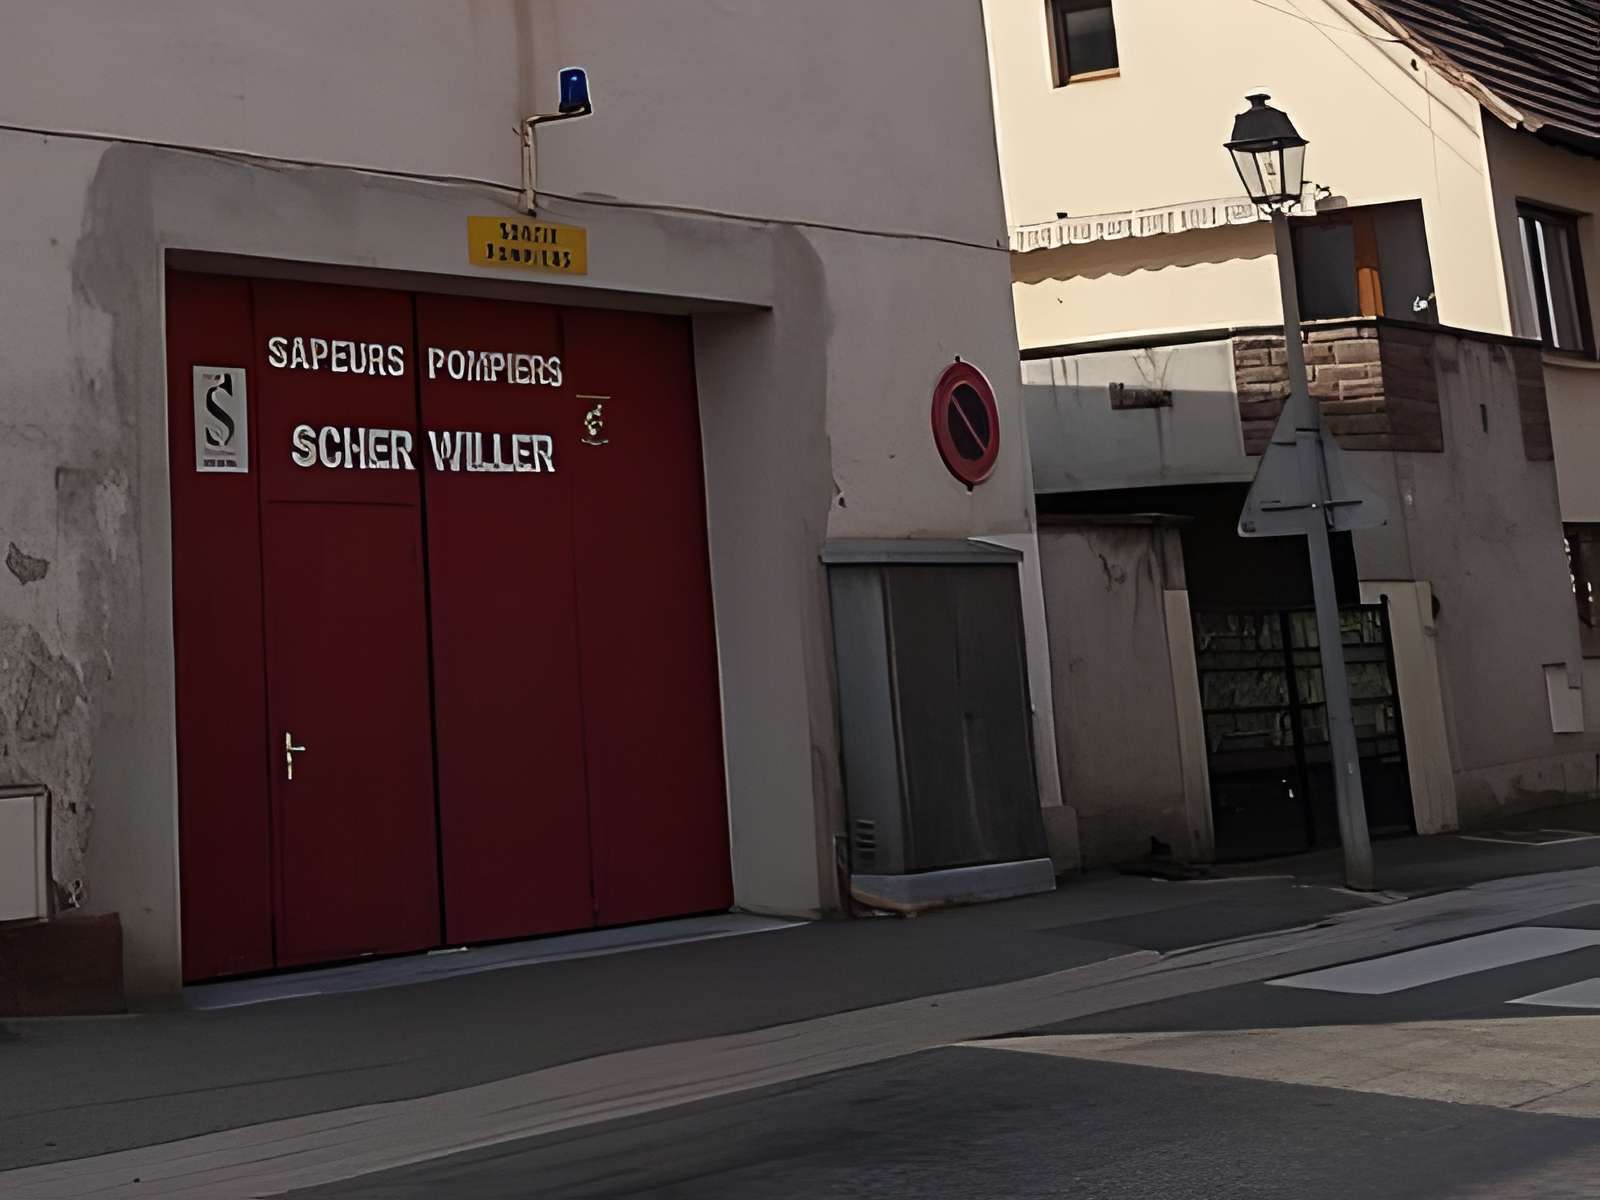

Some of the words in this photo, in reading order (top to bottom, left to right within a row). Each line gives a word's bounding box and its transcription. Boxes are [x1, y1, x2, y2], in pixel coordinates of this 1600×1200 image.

[268, 336, 404, 376] SAPEURS
[428, 347, 563, 387] POMPIERS
[291, 424, 416, 470] SCHER
[428, 430, 555, 472] WILLER
